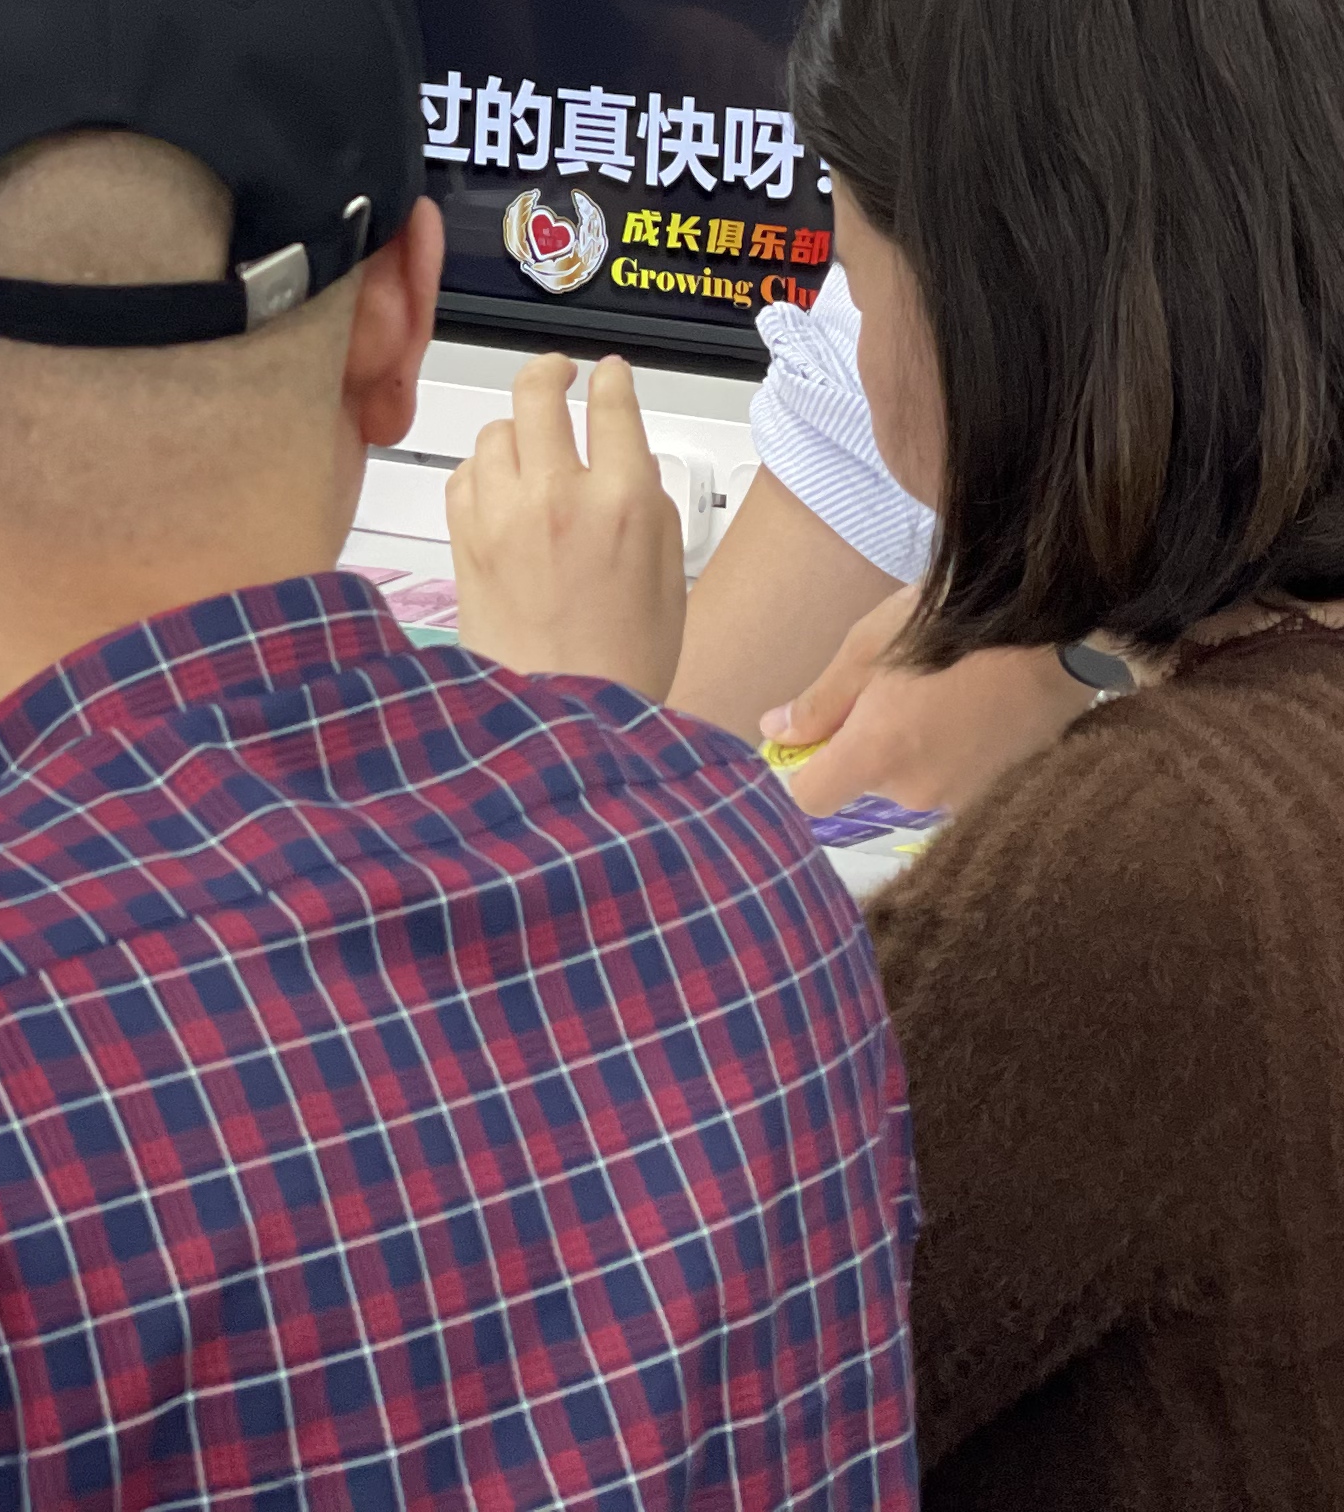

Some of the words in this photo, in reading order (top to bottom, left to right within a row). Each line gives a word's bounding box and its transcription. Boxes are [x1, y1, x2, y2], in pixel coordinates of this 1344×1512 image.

[622, 208, 833, 266] 成长俱乐部
[611, 256, 754, 309] Growing
